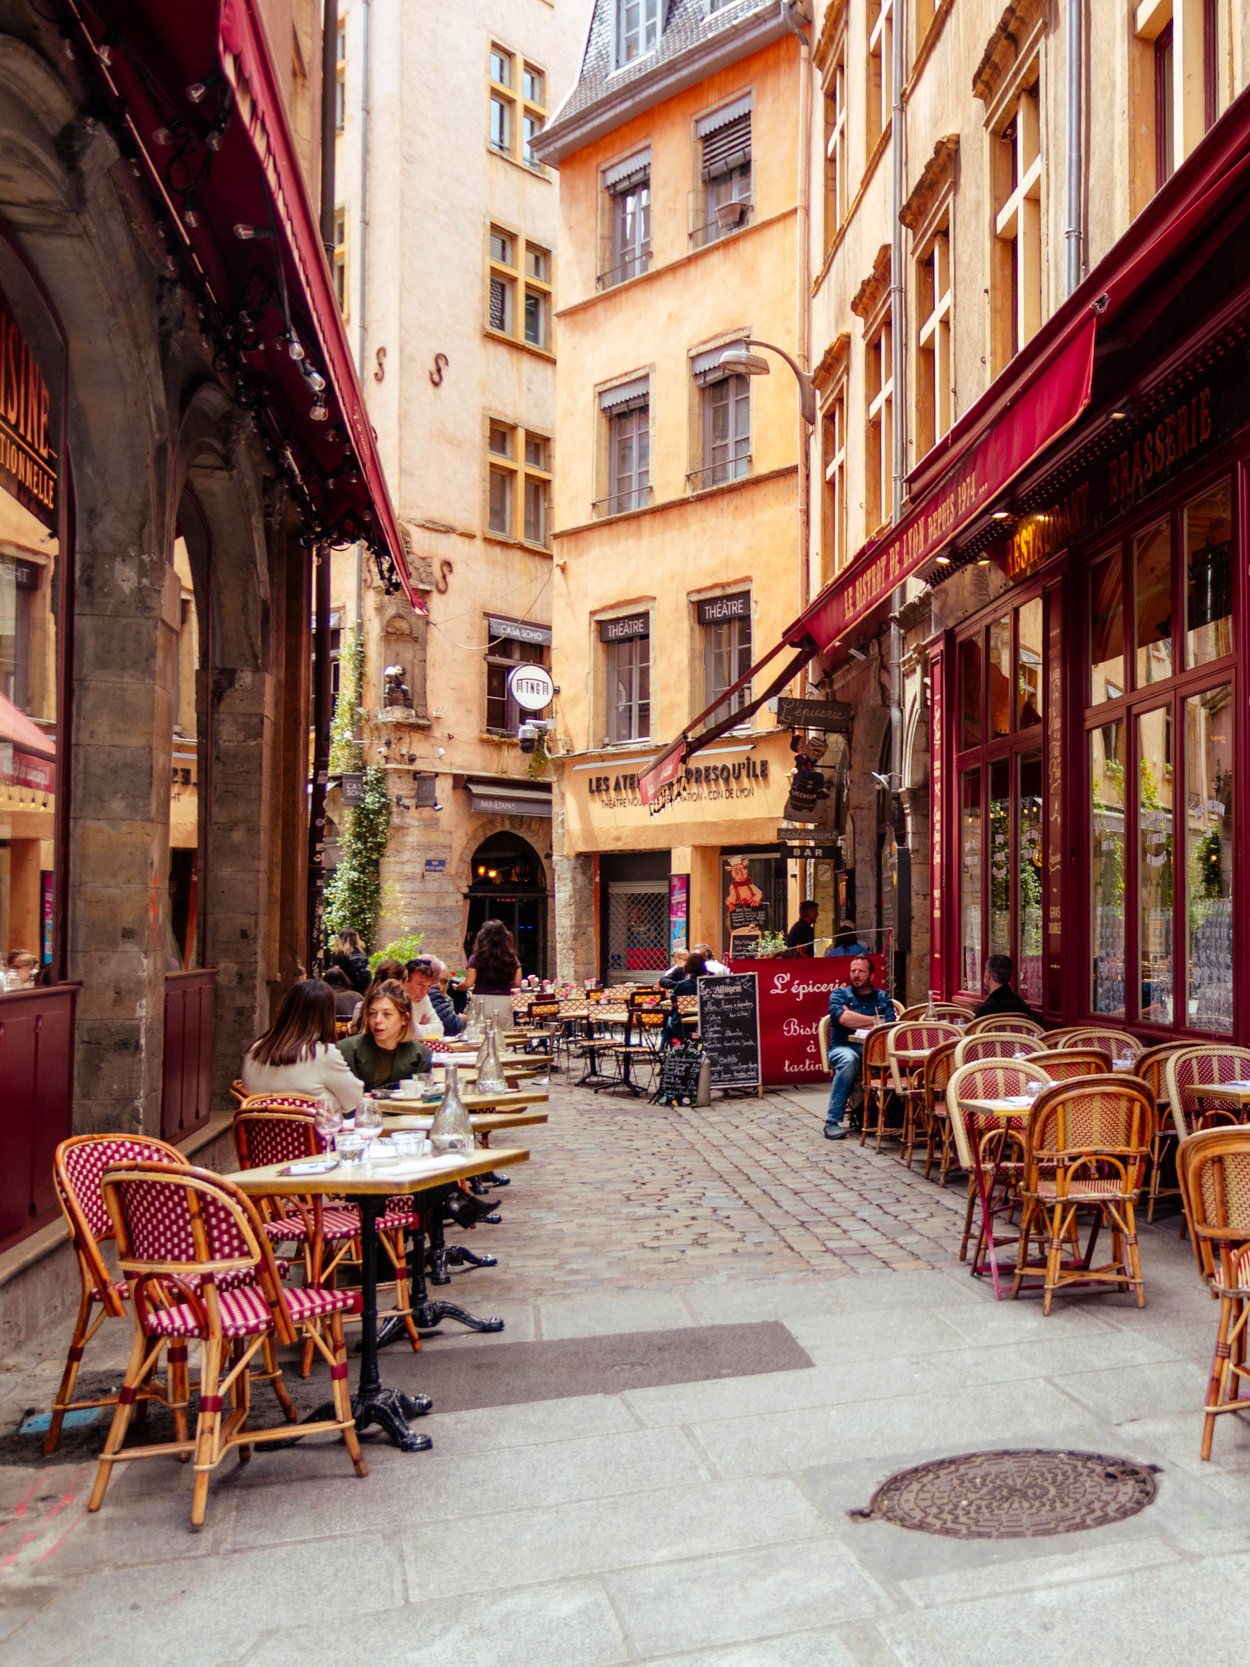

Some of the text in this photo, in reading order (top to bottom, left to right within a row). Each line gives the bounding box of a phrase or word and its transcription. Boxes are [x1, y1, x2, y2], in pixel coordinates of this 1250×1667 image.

[1109, 388, 1211, 504] BRASSERIE
[1007, 481, 1089, 578] RESTAURANT
[844, 586, 854, 620] LE
[855, 554, 887, 611] BISTROT
[889, 541, 900, 580] DE
[902, 515, 925, 569] LYON
[927, 494, 955, 544] DEPUIS
[957, 471, 976, 515] 1974
[704, 599, 744, 620] THÉÂTRE
[501, 625, 542, 640] CASA SOHO
[607, 616, 645, 638] THÉÂTRE
[525, 681, 540, 695] TNG
[779, 700, 845, 723] L'épicerie
[588, 777, 610, 794] LES
[725, 789, 735, 799] DE
[736, 788, 755, 798] LYON
[793, 848, 823, 857] BAR
[783, 1018, 820, 1036] Bist
[806, 1040, 817, 1053] à
[784, 1059, 823, 1072] tartin
